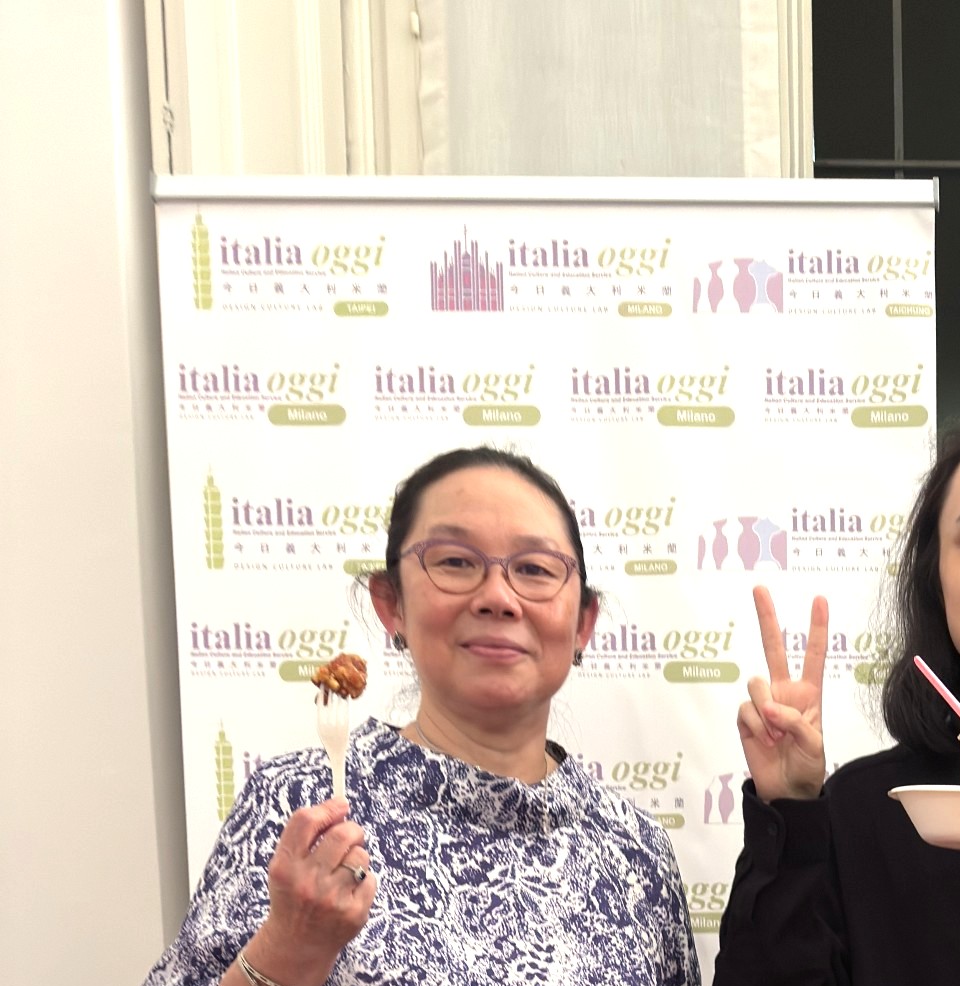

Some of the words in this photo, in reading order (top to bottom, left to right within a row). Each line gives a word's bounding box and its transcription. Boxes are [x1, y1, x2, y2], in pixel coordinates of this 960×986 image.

[220, 235, 303, 266] italia
[311, 234, 386, 276] oggi
[509, 238, 589, 267] italia
[598, 237, 672, 277] oggi
[788, 248, 860, 274] italia
[867, 250, 932, 281] oggi
[628, 304, 663, 314] MILANO
[179, 363, 260, 393] italia
[267, 362, 340, 402] oggi
[375, 365, 456, 394] italia
[462, 363, 535, 402] oggi
[571, 366, 650, 395] italia
[656, 364, 730, 403] oggi
[765, 368, 845, 396] italia
[851, 363, 924, 403] oggi
[287, 408, 328, 421] Milano
[482, 409, 522, 422] Milano
[676, 410, 716, 423] Milano
[870, 410, 909, 424] Milano
[232, 496, 314, 526] italia
[605, 496, 676, 536] oggi
[791, 507, 863, 533] italia
[633, 563, 668, 573] MILANO
[190, 621, 272, 651] italia
[277, 619, 350, 659] oggi
[590, 623, 657, 652] talia
[662, 621, 735, 659] oggi
[682, 665, 721, 679] Milano
[611, 751, 683, 791] oggi
